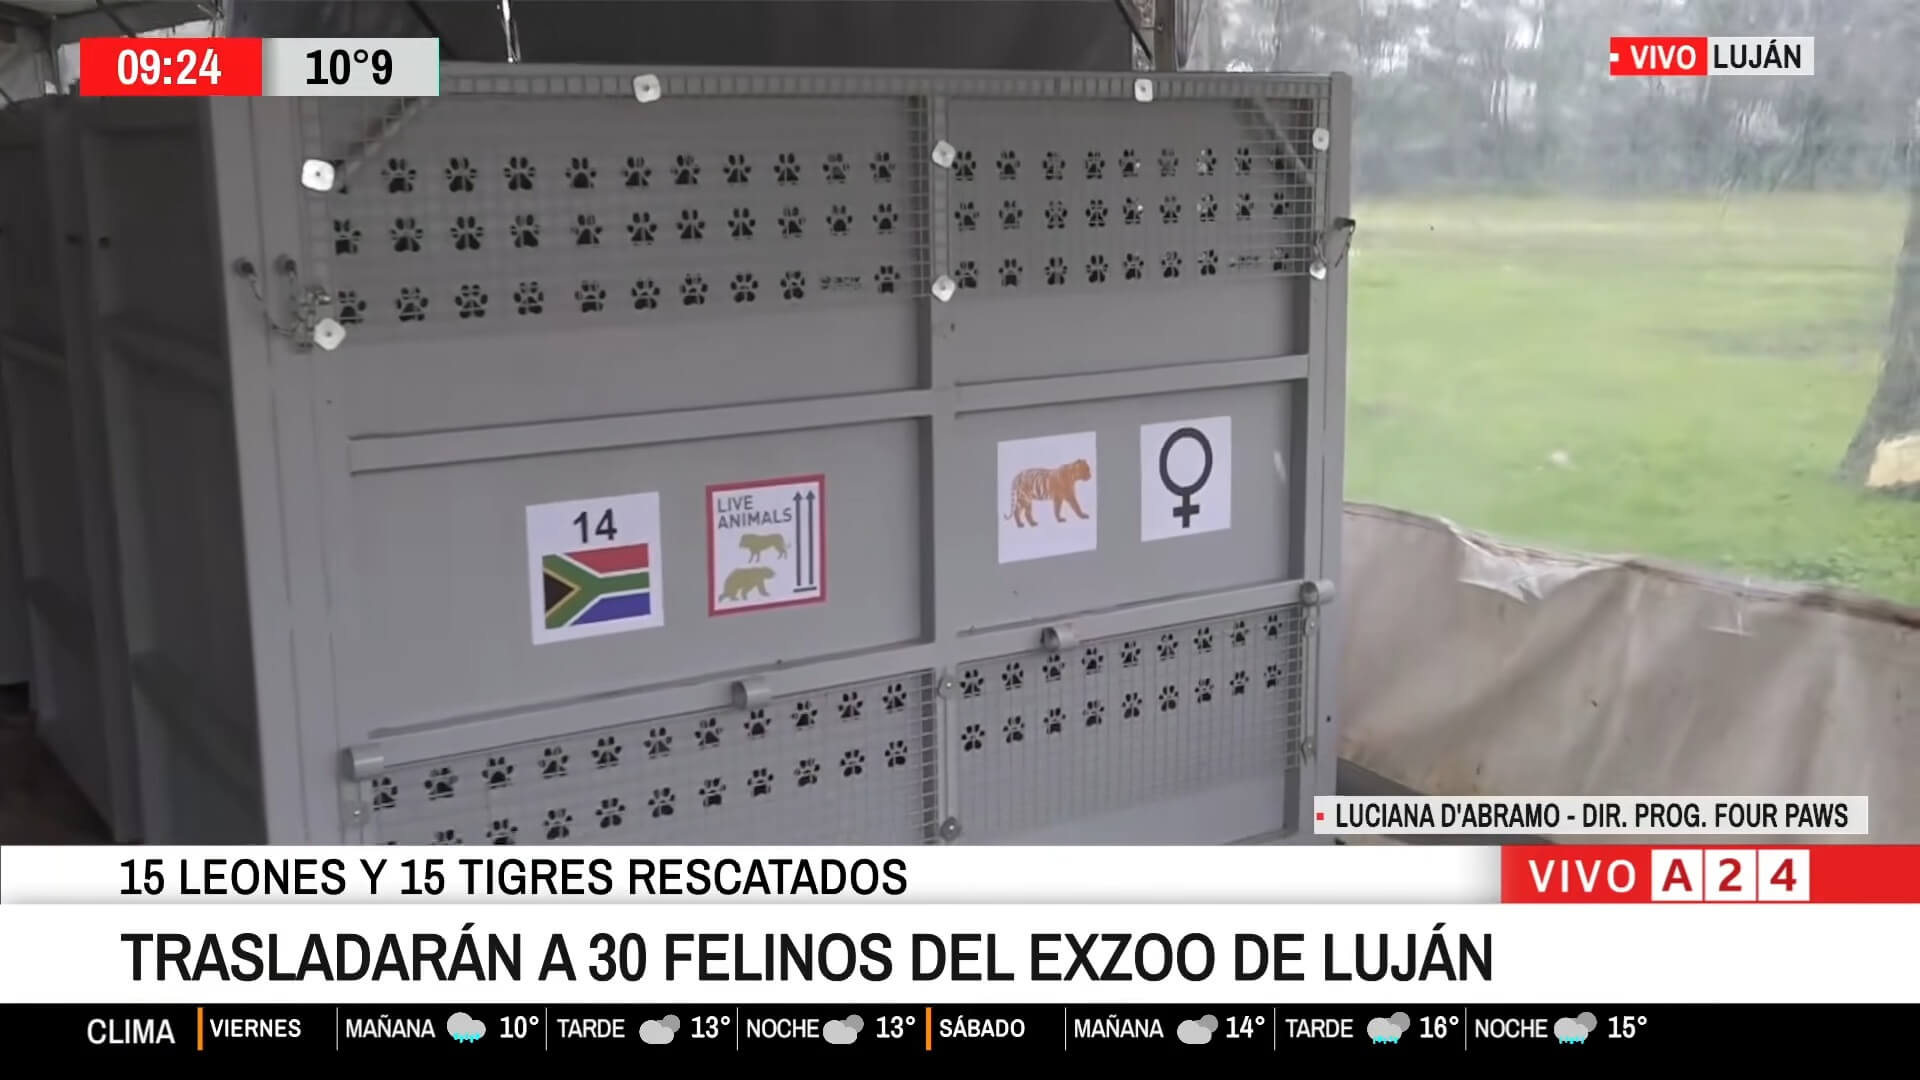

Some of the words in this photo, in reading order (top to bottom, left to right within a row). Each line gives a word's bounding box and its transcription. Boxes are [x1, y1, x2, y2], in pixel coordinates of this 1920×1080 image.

[717, 495, 754, 513] LIVE
[572, 507, 618, 544] 14
[717, 509, 793, 530] ANIMALS
